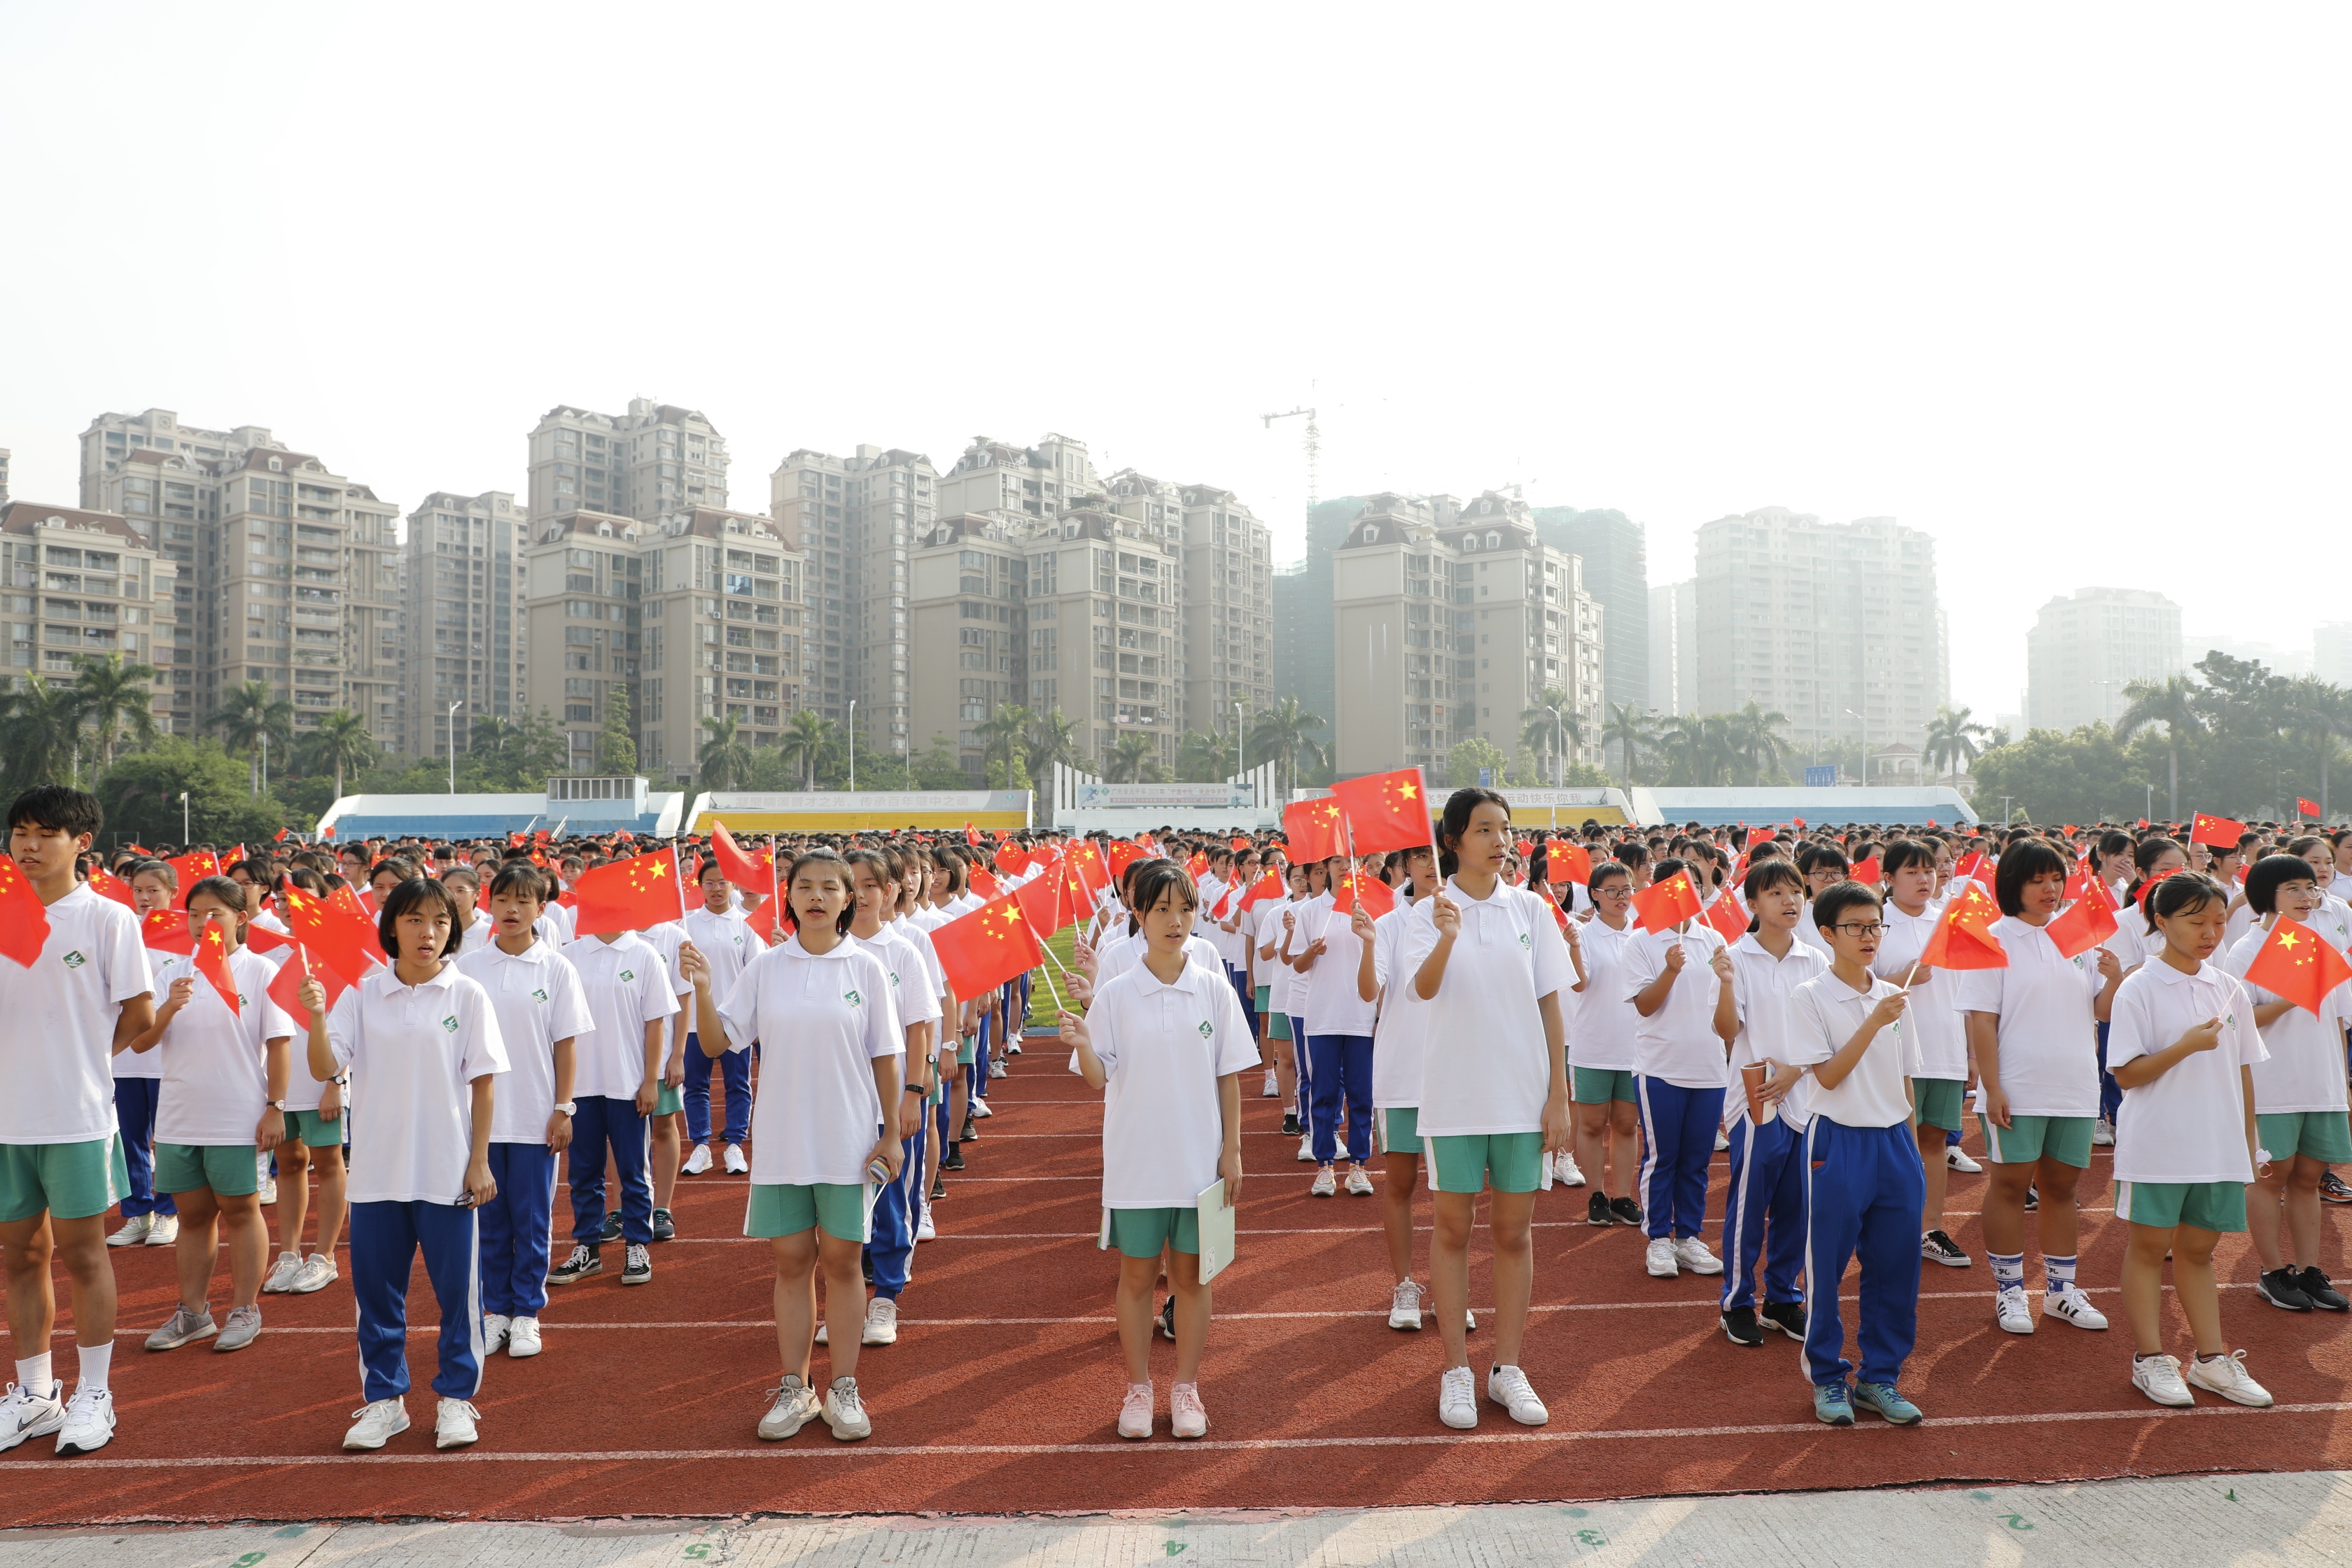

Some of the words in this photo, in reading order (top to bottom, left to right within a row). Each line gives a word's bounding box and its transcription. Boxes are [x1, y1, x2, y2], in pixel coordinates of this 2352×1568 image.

[1996, 1514, 2036, 1531] 2
[1576, 1530, 1606, 1546] 3
[681, 1543, 713, 1561] 5
[1161, 1541, 1190, 1558] 4
